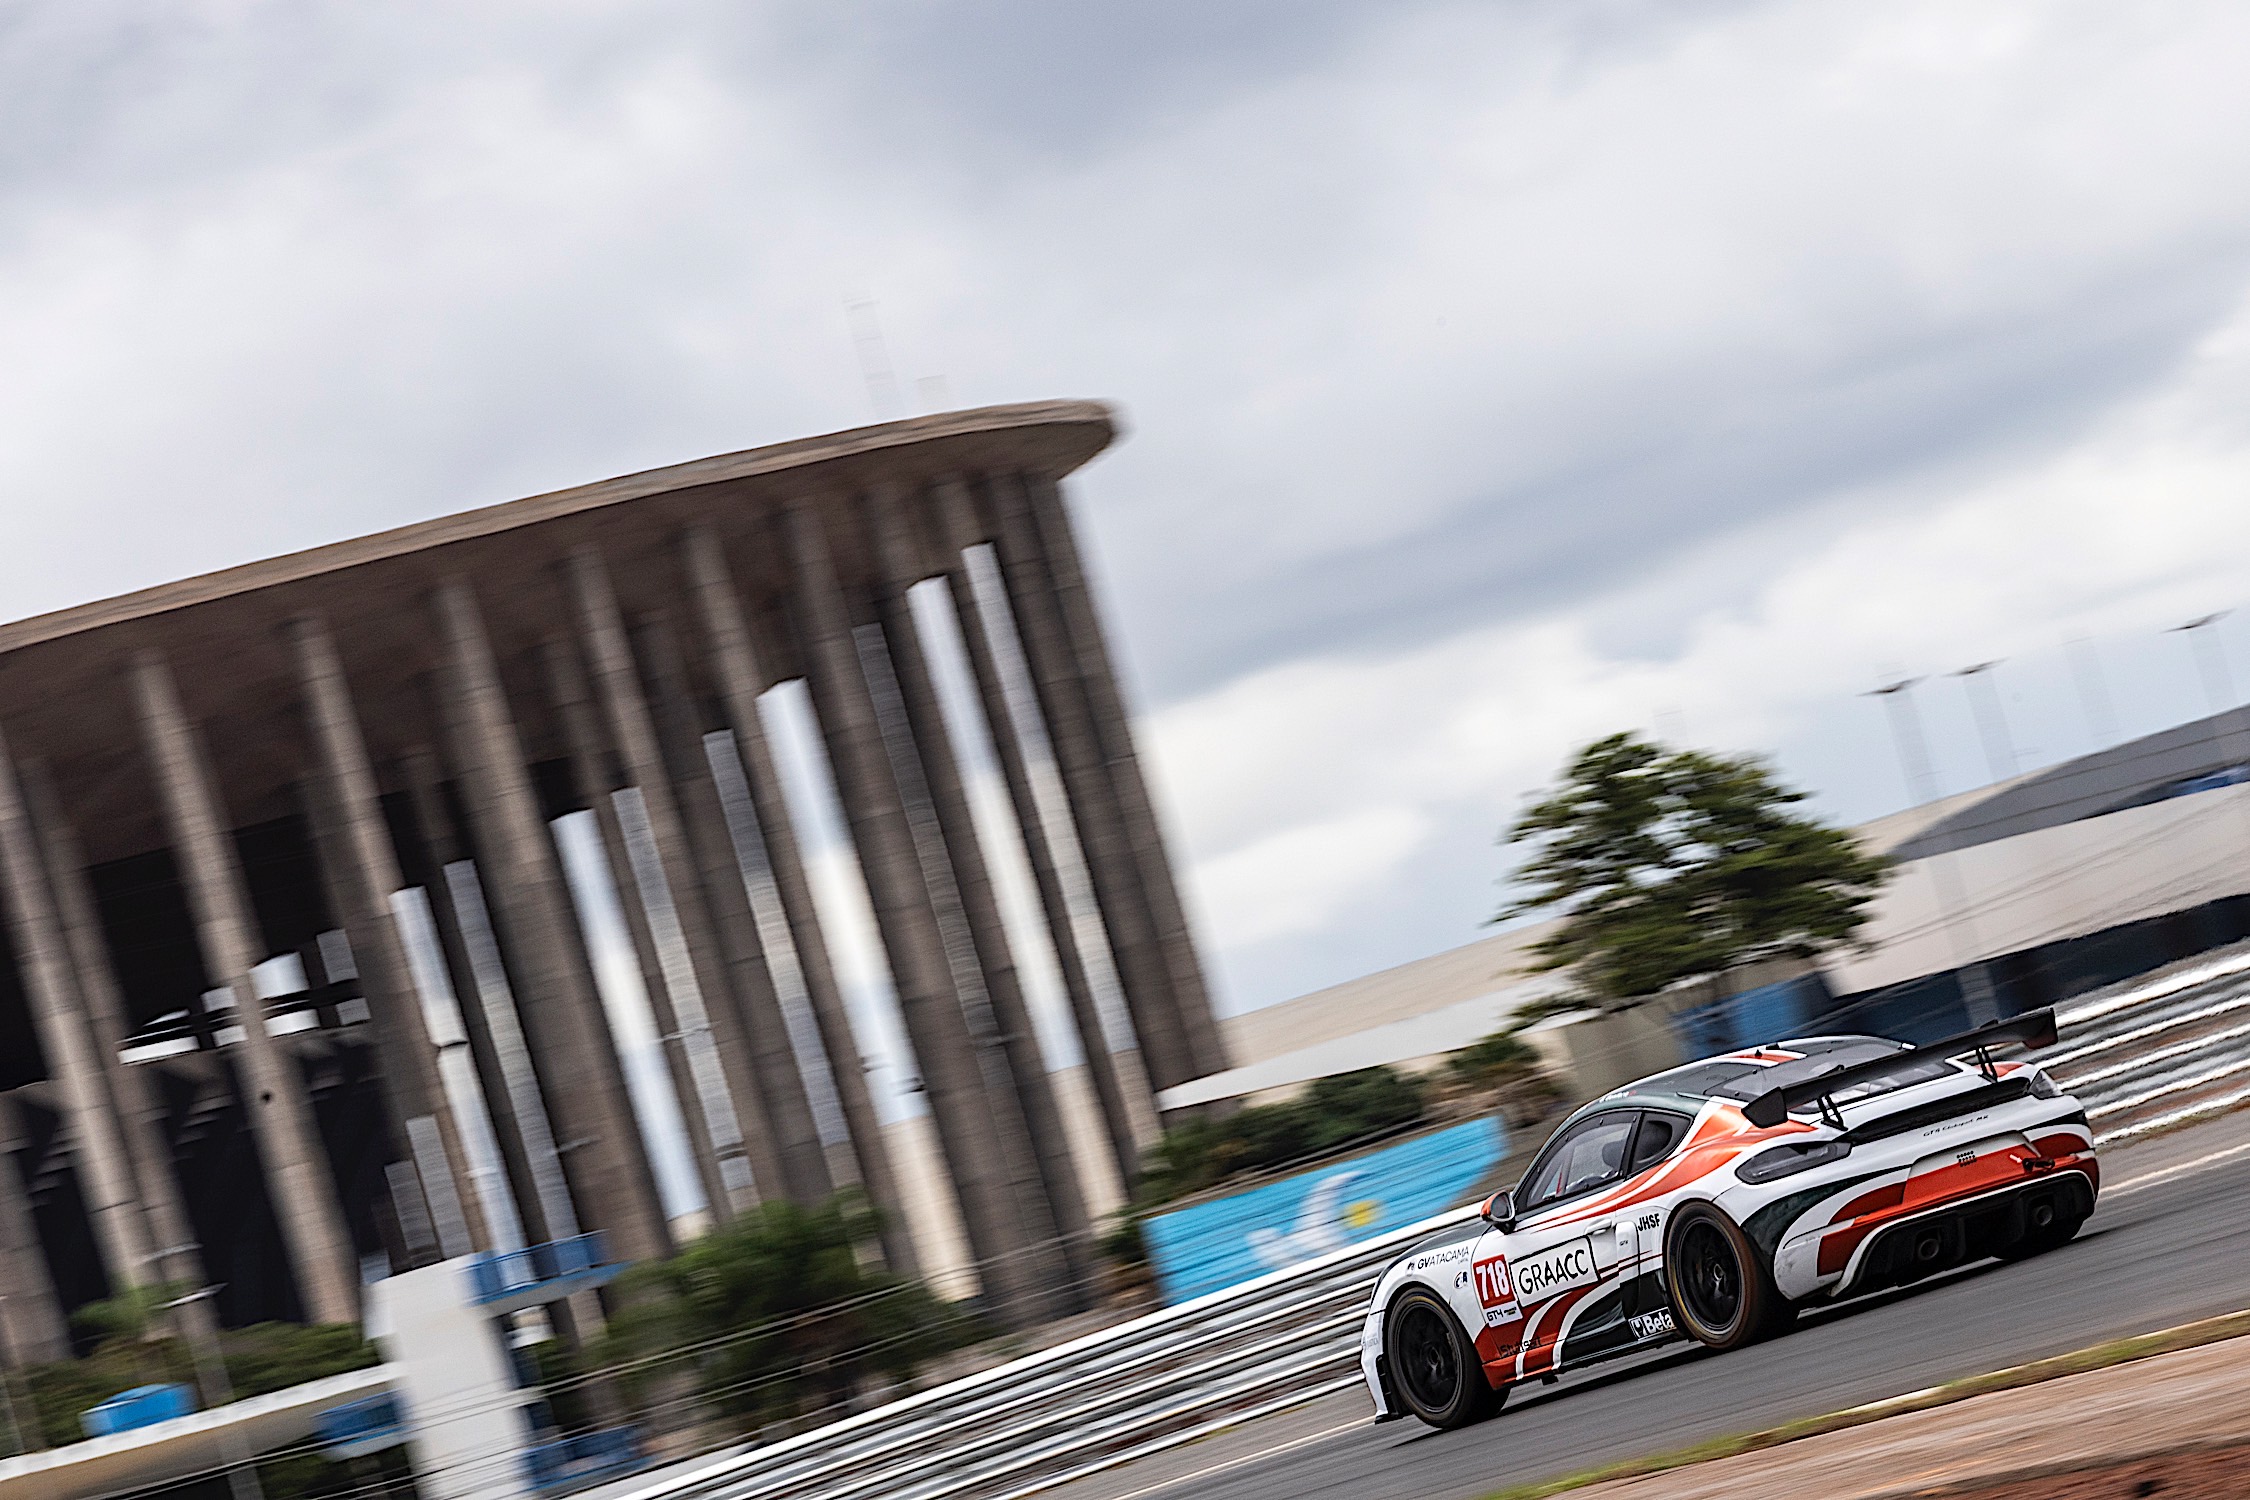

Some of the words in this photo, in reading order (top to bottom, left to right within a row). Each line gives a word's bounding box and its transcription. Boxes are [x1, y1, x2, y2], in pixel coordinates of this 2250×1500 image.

[1637, 1212, 1660, 1231] JHSF
[1475, 1259, 1510, 1301] 718
[1519, 1249, 1588, 1294] GRAACC
[1486, 1308, 1504, 1321] GT4
[1642, 1311, 1675, 1334] Beta
